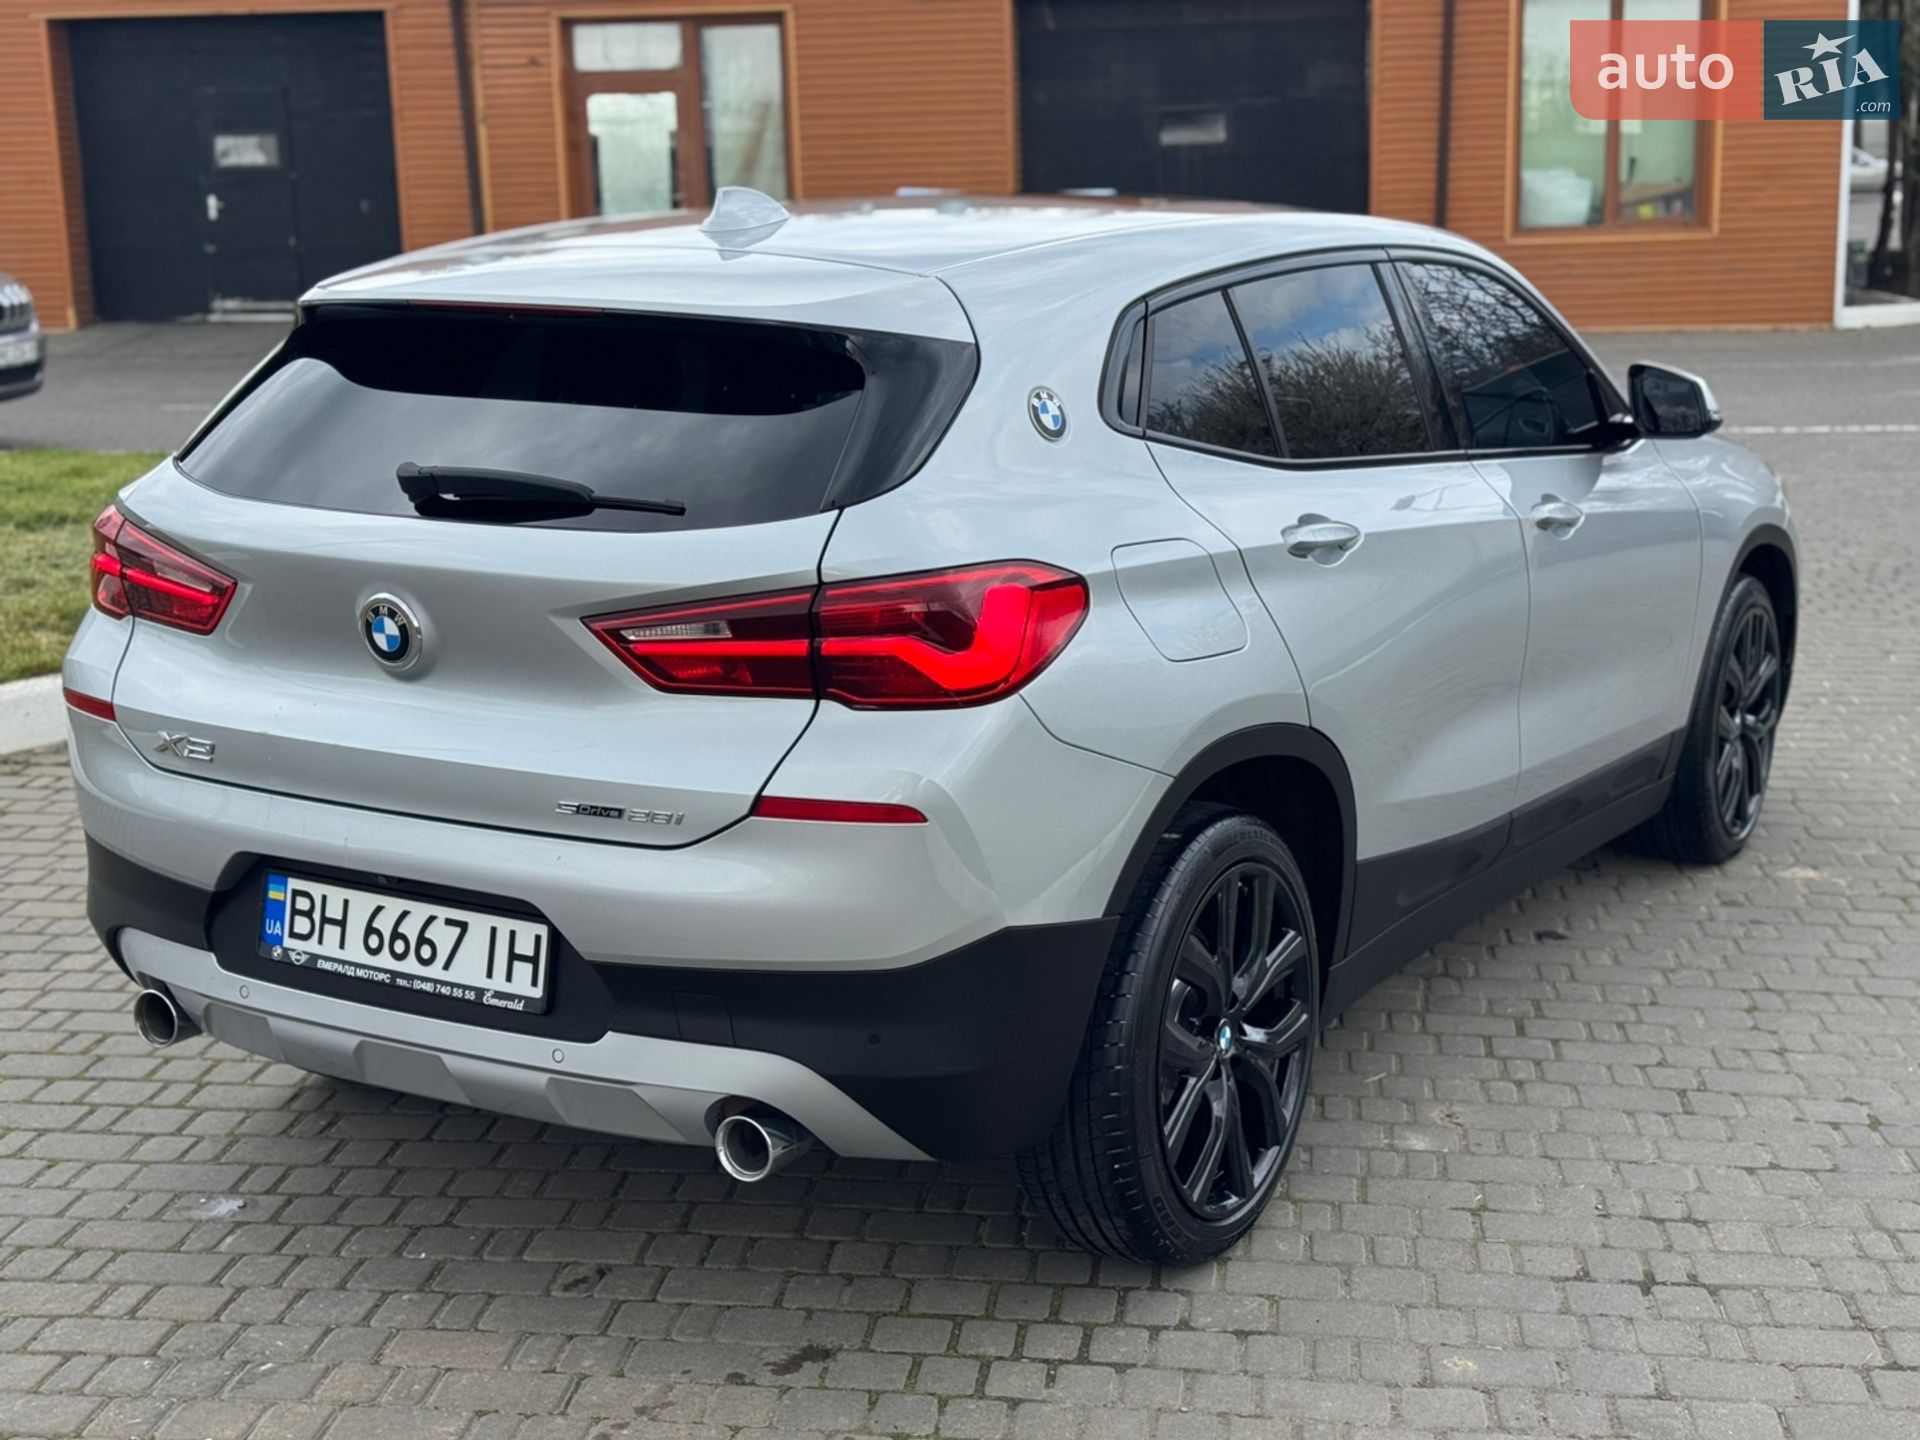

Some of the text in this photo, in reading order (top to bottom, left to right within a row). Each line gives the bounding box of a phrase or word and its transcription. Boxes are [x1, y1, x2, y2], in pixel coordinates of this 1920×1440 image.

[367, 606, 406, 626] BMW
[152, 730, 216, 763] X2
[265, 919, 283, 936] UA
[288, 888, 542, 988] BH 6667 IH
[316, 959, 355, 976] ЕМЕРАЛД
[355, 968, 391, 983] МОТОРС
[412, 979, 435, 994] (048)
[435, 983, 452, 996] 740
[451, 987, 464, 998] 55
[463, 989, 476, 1001] 55
[482, 990, 525, 1011] Emerald
